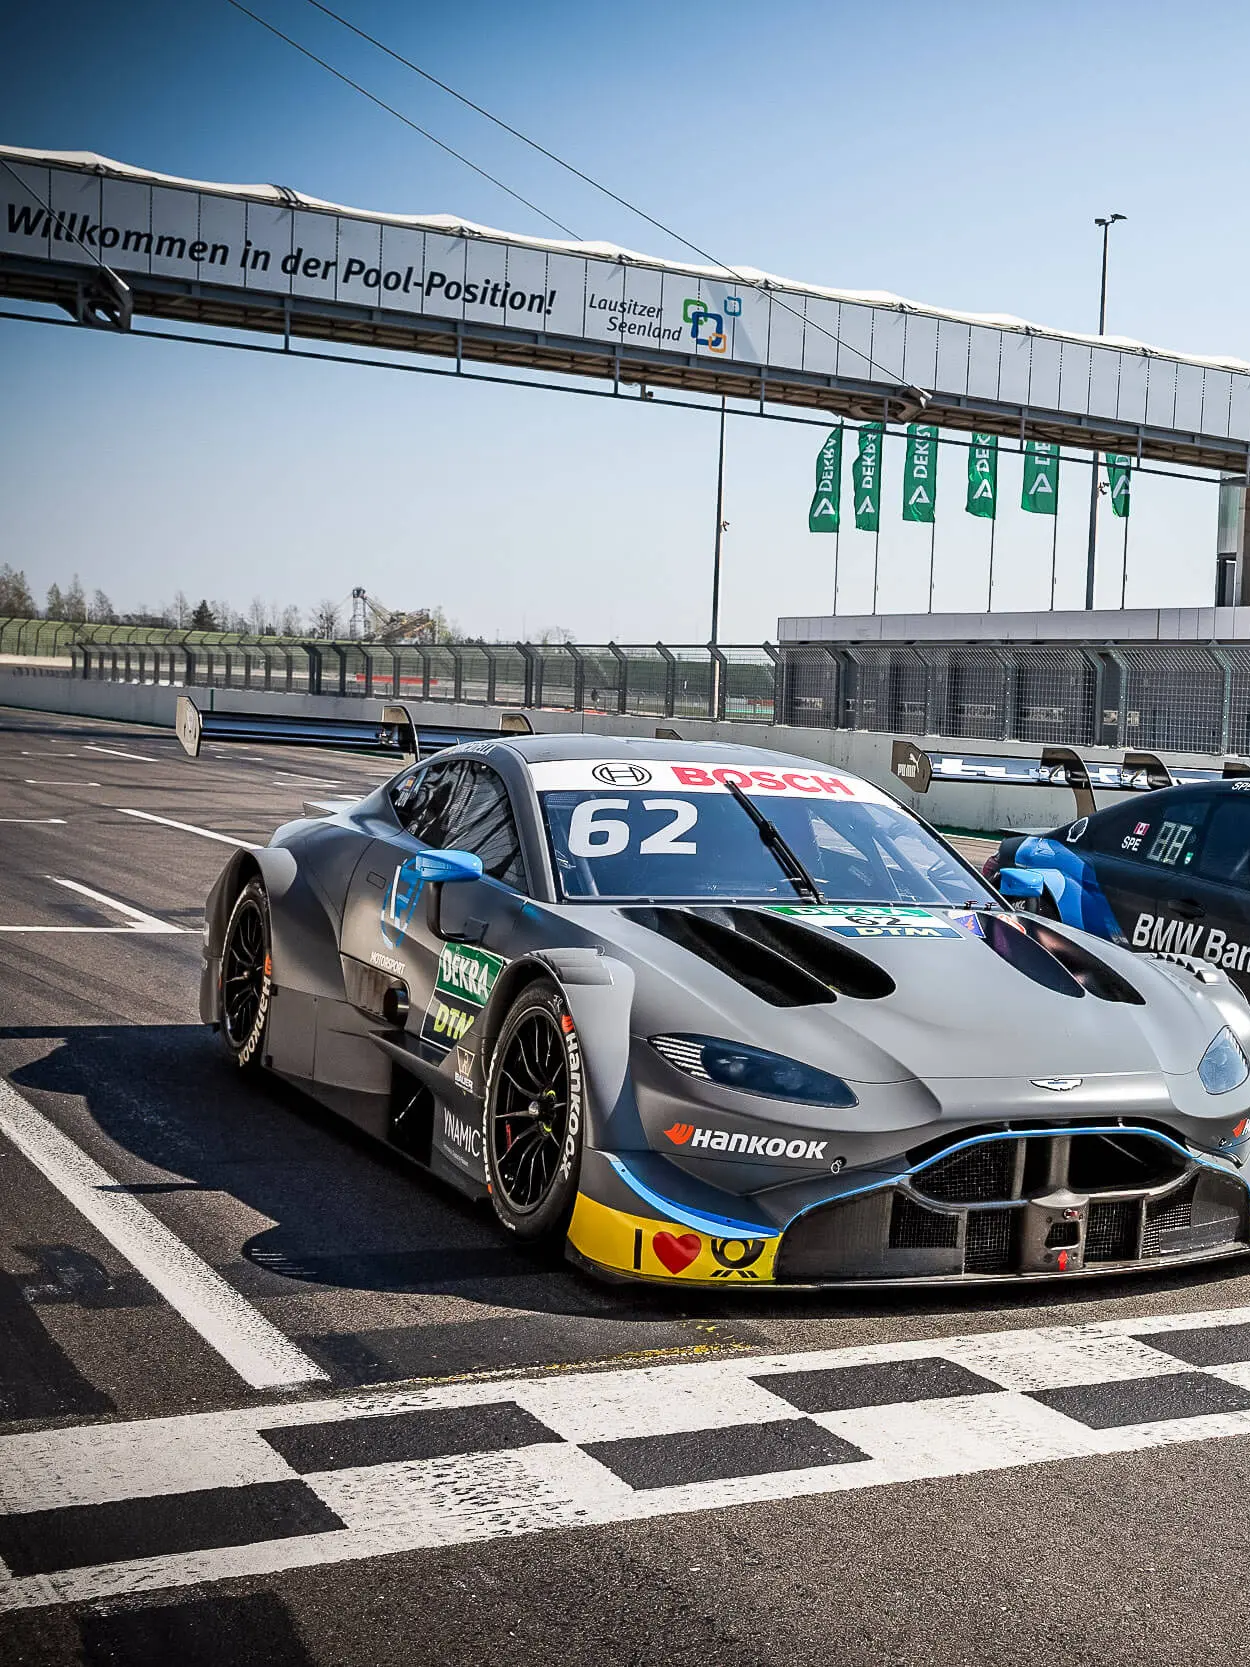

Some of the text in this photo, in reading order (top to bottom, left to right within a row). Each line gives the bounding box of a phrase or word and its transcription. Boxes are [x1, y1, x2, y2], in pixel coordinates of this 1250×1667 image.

[7, 203, 557, 316] Willkommen in der Pool-Position!
[588, 293, 664, 320] Lausitzer
[606, 315, 682, 342] Seenland
[975, 434, 991, 473] DEK
[670, 766, 855, 796] BOSCH
[897, 763, 916, 778] PUMA
[567, 799, 699, 859] 62
[1121, 835, 1142, 852] SPE
[845, 915, 912, 926] 62
[856, 927, 942, 937] DTM
[1132, 912, 1204, 956] BMW
[369, 951, 406, 976] MOTORSPORT
[441, 950, 489, 998] DEKRA
